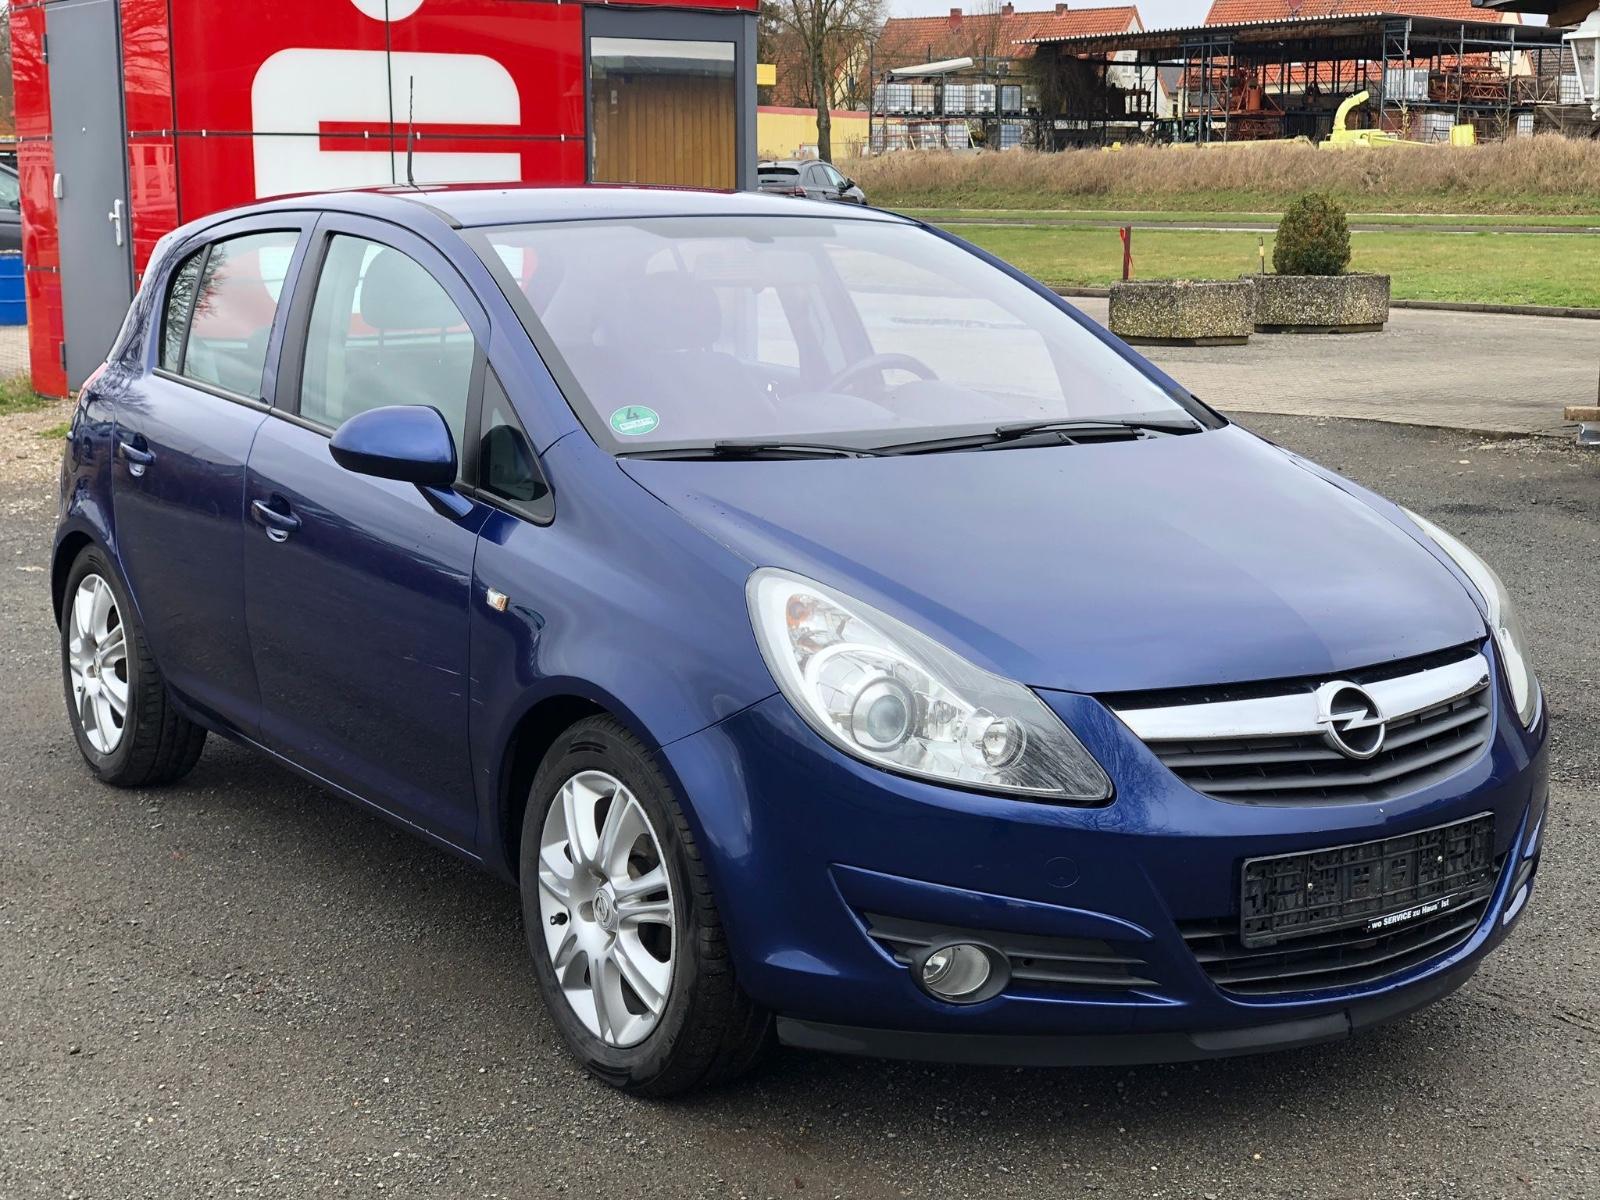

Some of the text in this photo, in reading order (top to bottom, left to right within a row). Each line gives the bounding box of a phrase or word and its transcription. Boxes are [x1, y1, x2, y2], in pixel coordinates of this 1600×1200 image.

[626, 407, 641, 420] 4
[1383, 911, 1412, 926] SERVICE
[1412, 909, 1421, 918] zu
